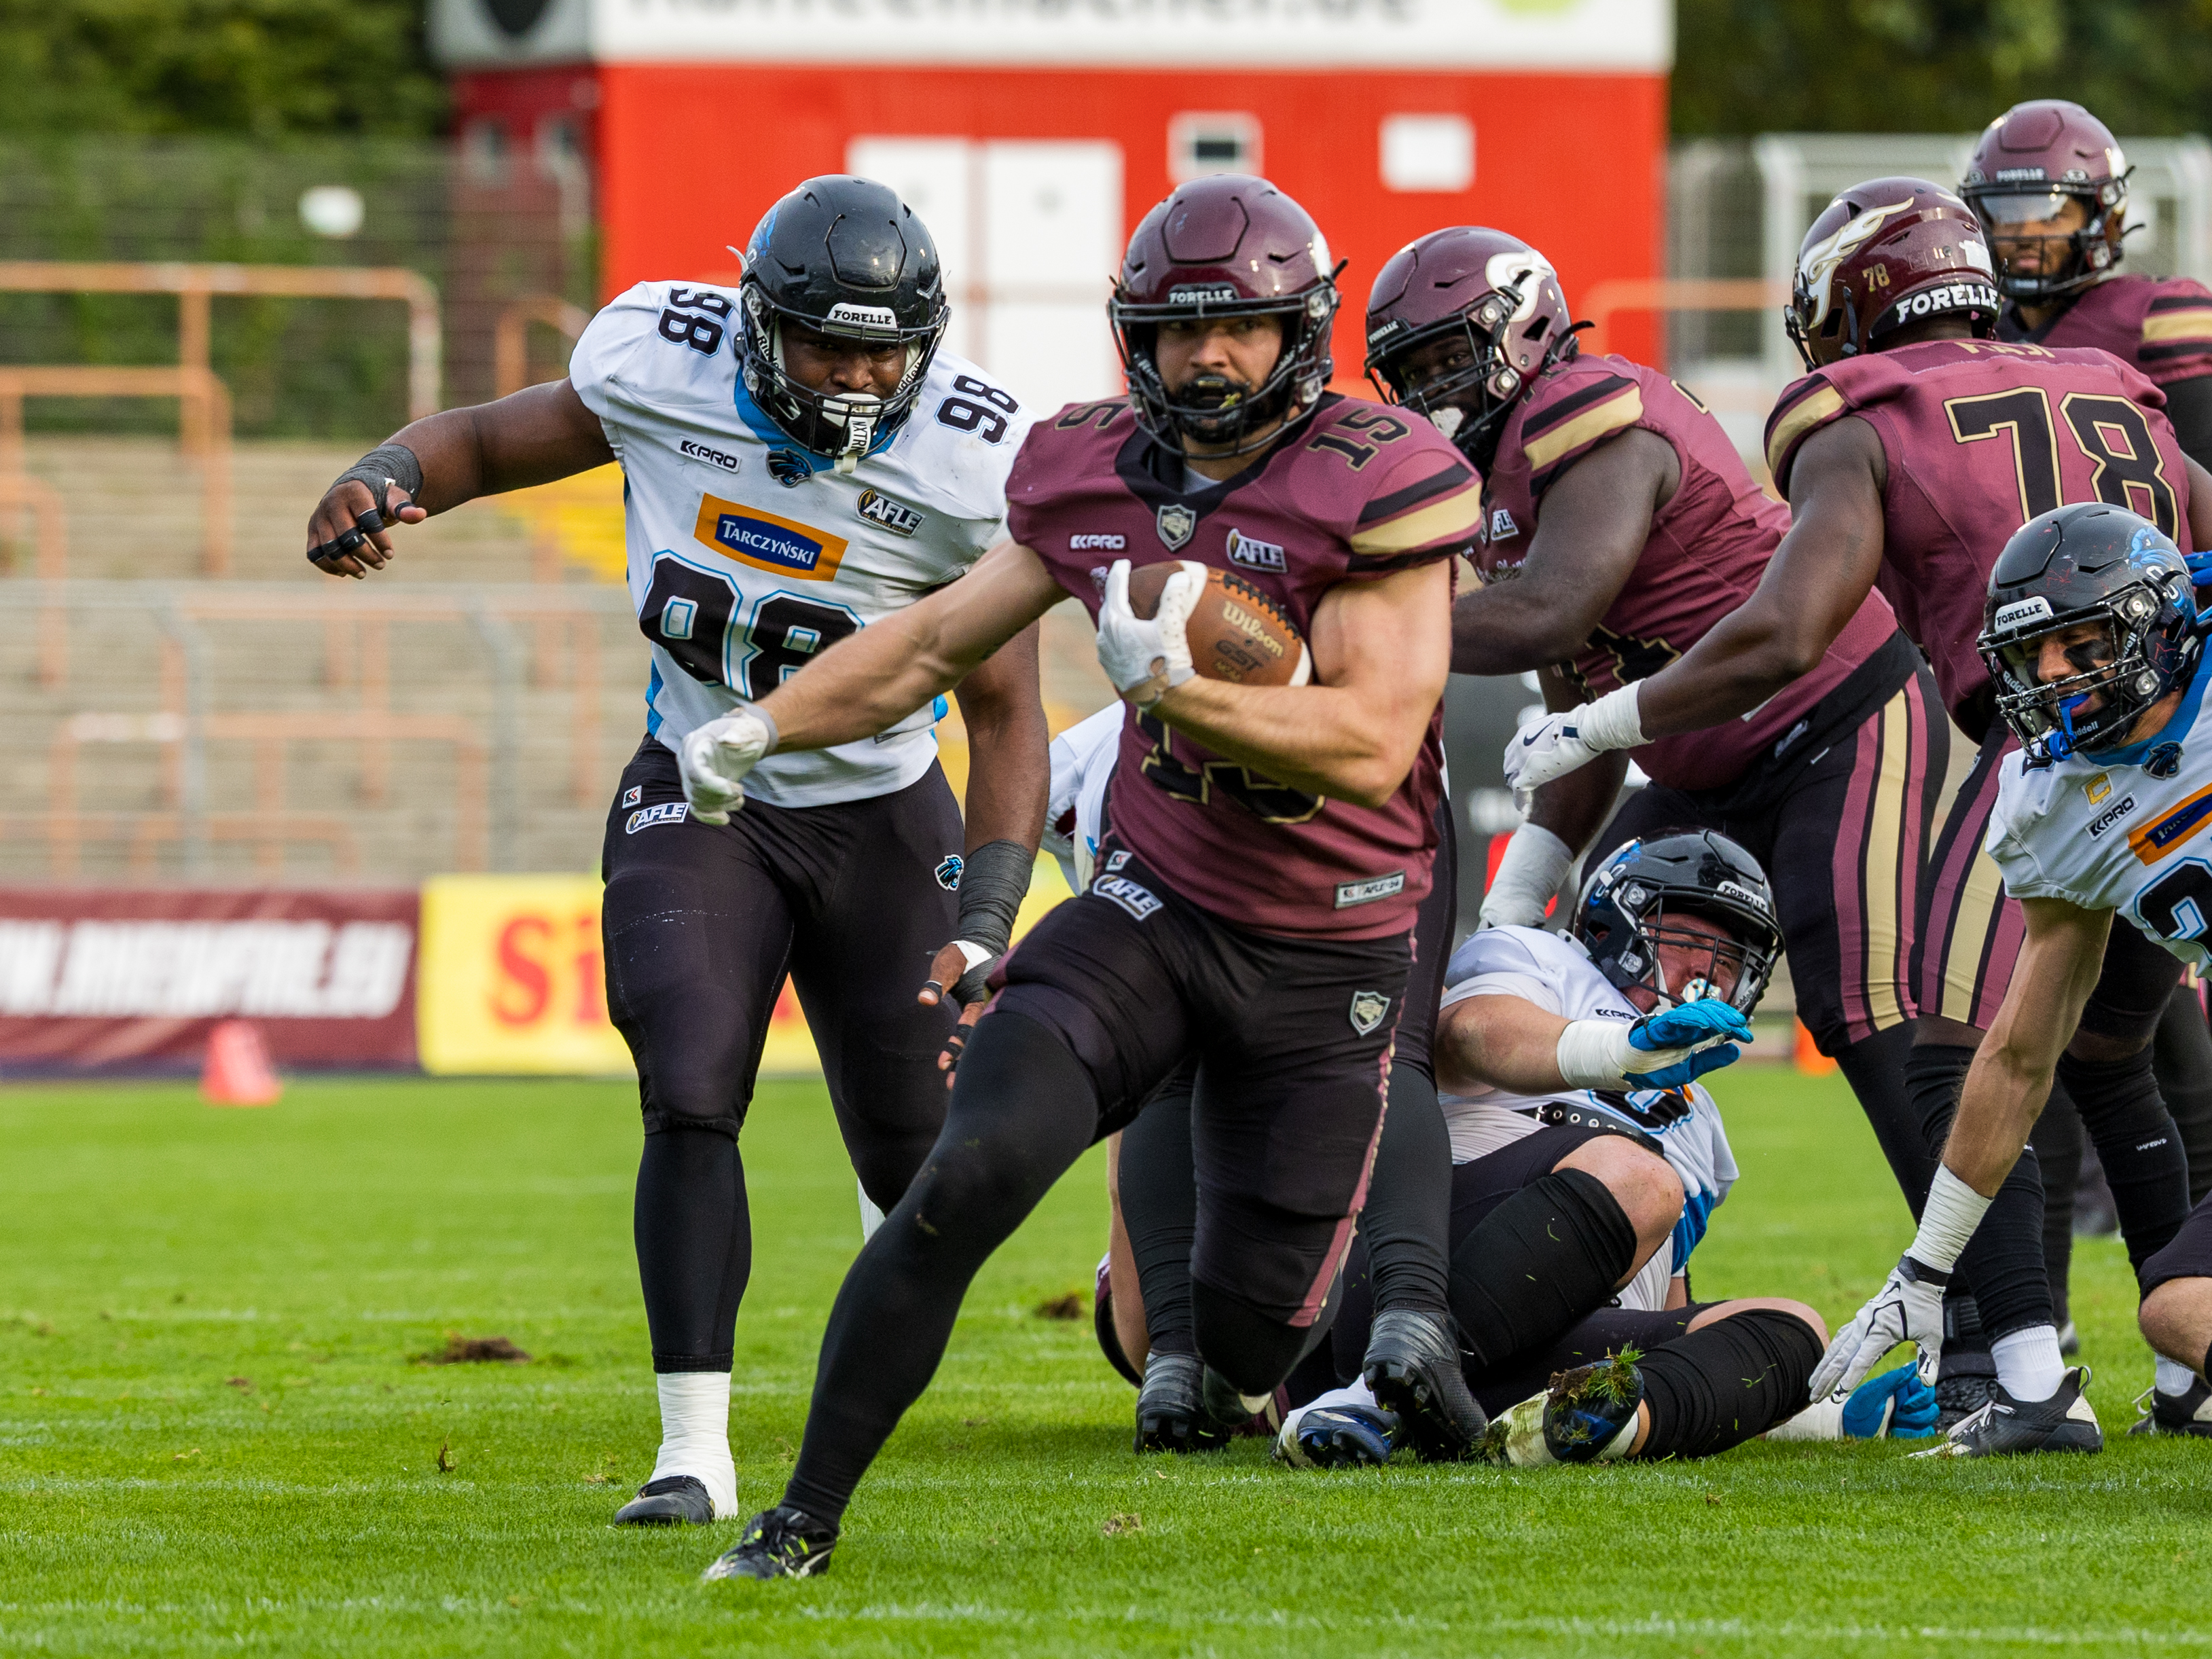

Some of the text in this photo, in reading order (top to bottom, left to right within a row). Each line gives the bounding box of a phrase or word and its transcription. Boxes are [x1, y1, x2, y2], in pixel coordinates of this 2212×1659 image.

[1862, 263, 1890, 292] 78
[1170, 289, 1233, 304] FORELLE
[1896, 284, 1998, 324] FORELLE
[833, 309, 892, 325] FORELLE
[935, 373, 1021, 447] 98
[1305, 407, 1412, 472] 15
[1943, 386, 2181, 546] 78
[863, 497, 922, 531] AFLE
[1070, 534, 1126, 549] KPRO
[1234, 539, 1283, 567] AFLE
[1222, 600, 1284, 658] Wilson
[1997, 603, 2043, 626] FORELLE
[2073, 721, 2099, 737] iddell
[634, 805, 686, 828] AFLE
[1100, 879, 1159, 913] AFLE
